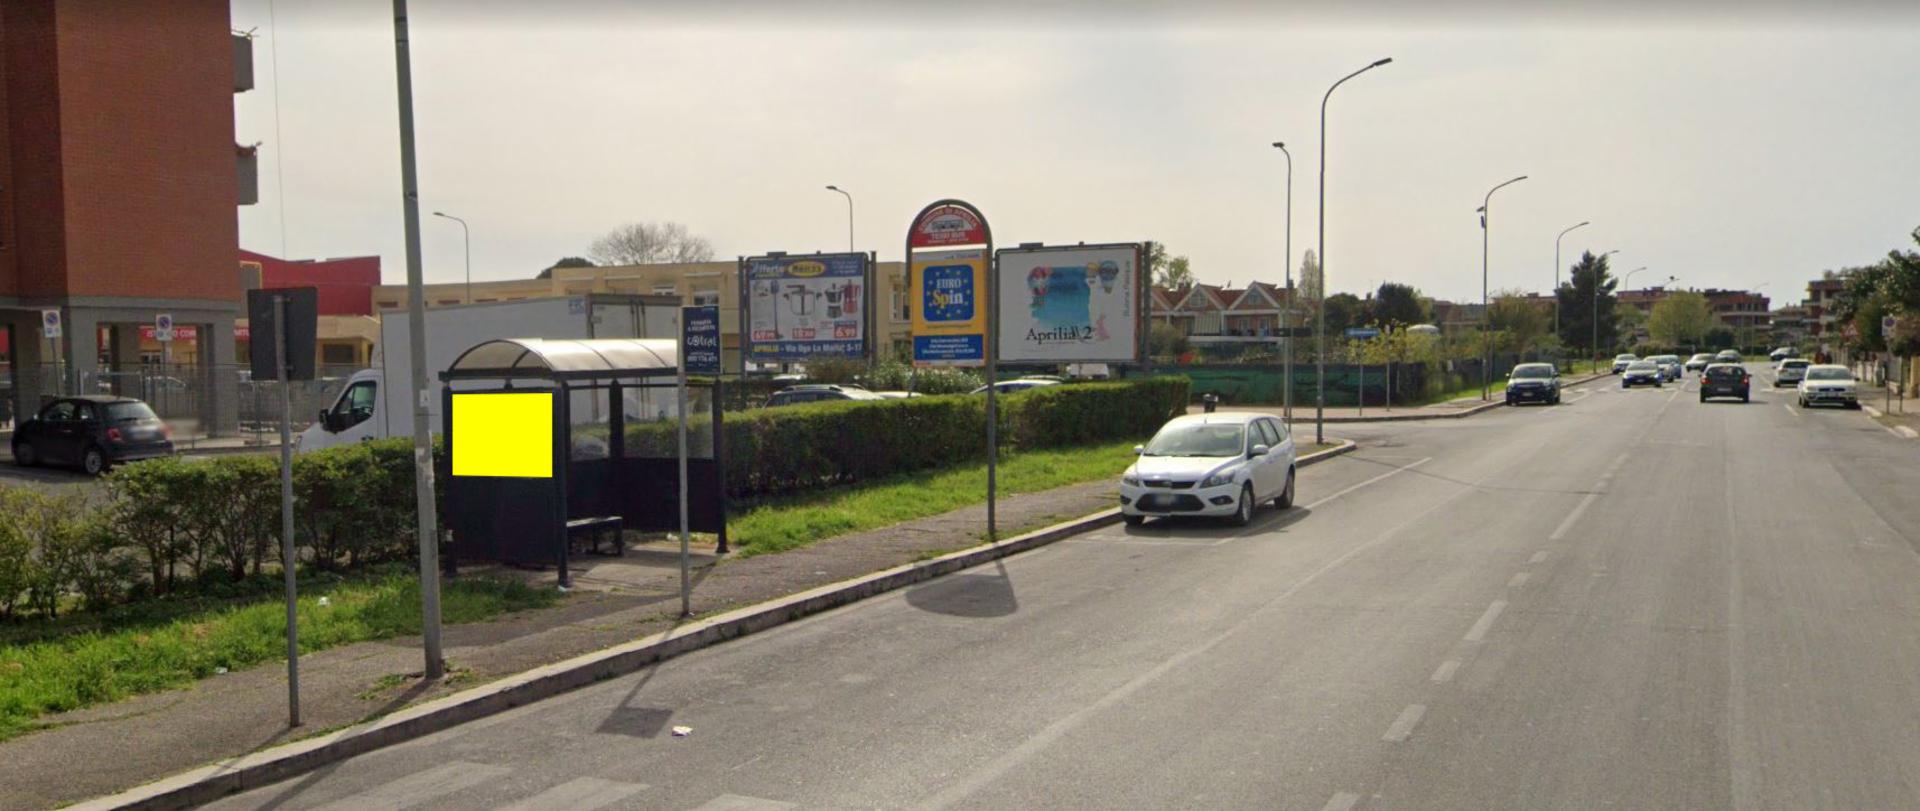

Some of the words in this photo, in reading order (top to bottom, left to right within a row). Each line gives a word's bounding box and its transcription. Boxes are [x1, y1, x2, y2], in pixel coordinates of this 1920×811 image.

[936, 278, 962, 289] EURO
[932, 289, 964, 309] Spin
[753, 344, 779, 353] APRILIA
[785, 344, 795, 352] Via
[798, 344, 811, 353] Ugo
